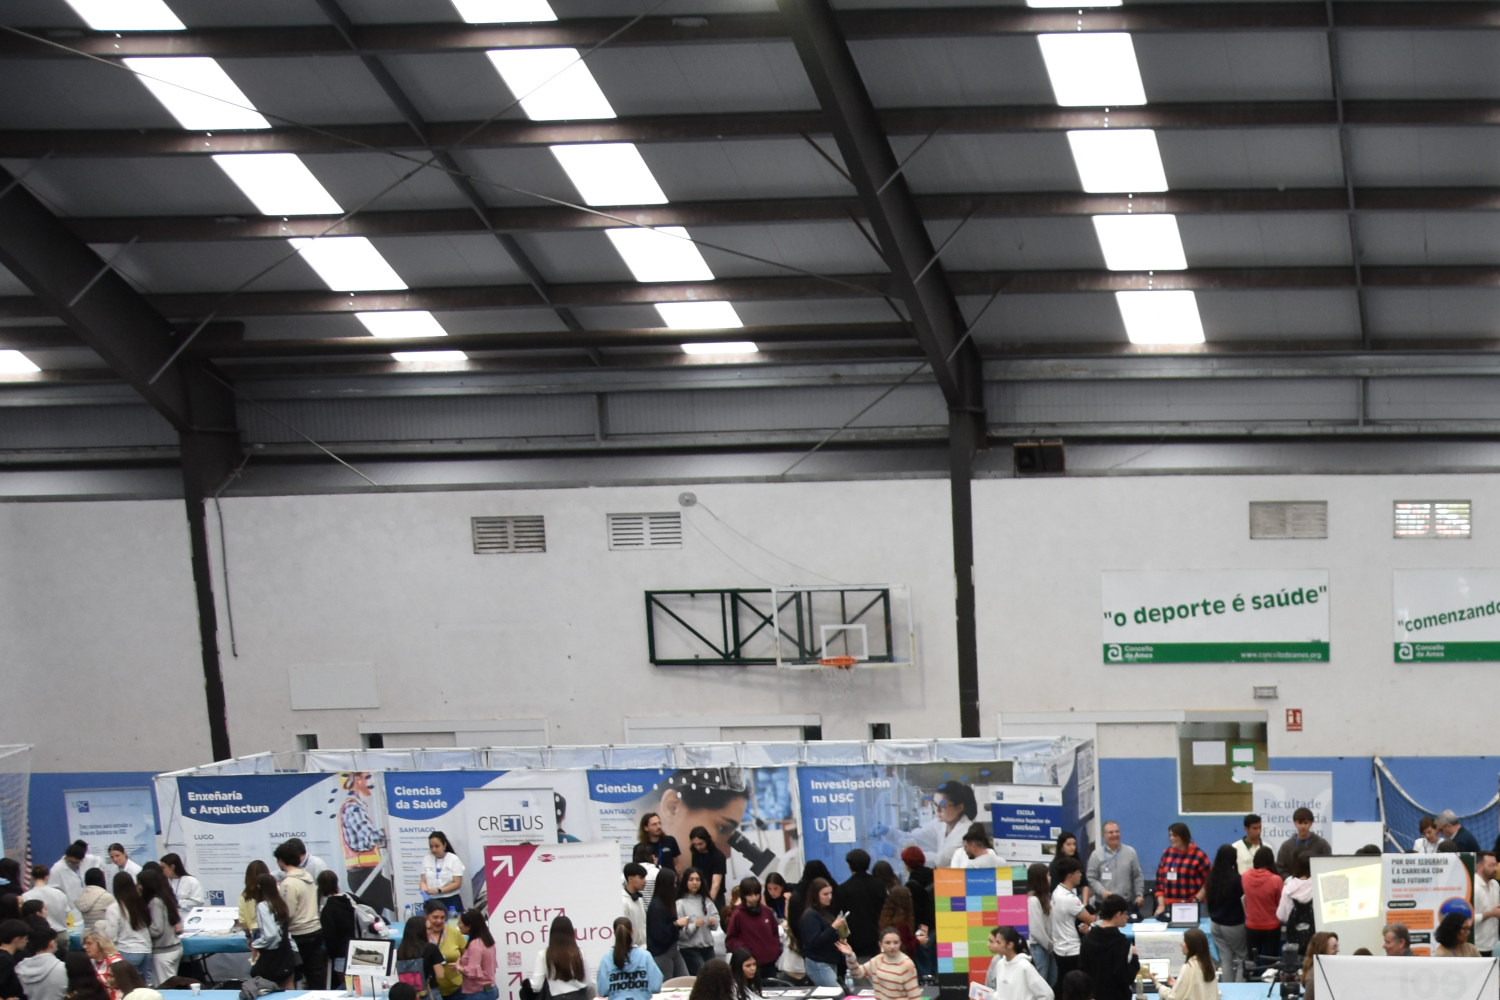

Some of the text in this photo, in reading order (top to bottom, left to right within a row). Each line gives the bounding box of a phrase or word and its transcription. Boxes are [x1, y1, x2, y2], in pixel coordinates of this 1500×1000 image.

[1104, 585, 1327, 627] "o deporte é saúde"
[1415, 643, 1445, 651] Concello
[596, 784, 643, 794] Ciencias
[811, 779, 890, 791] Investigación
[187, 790, 243, 801] Enxeñaría
[394, 786, 441, 796] Ciencias
[829, 793, 855, 803] USC
[1263, 798, 1321, 809] Facultade
[190, 803, 270, 816] e Arquitectura
[396, 799, 448, 810] da Saúde
[478, 815, 544, 832] CRETUS
[814, 816, 851, 832] USC
[269, 831, 306, 839] SANTIAGO
[506, 925, 612, 945] no furo
[609, 979, 648, 990] motion
